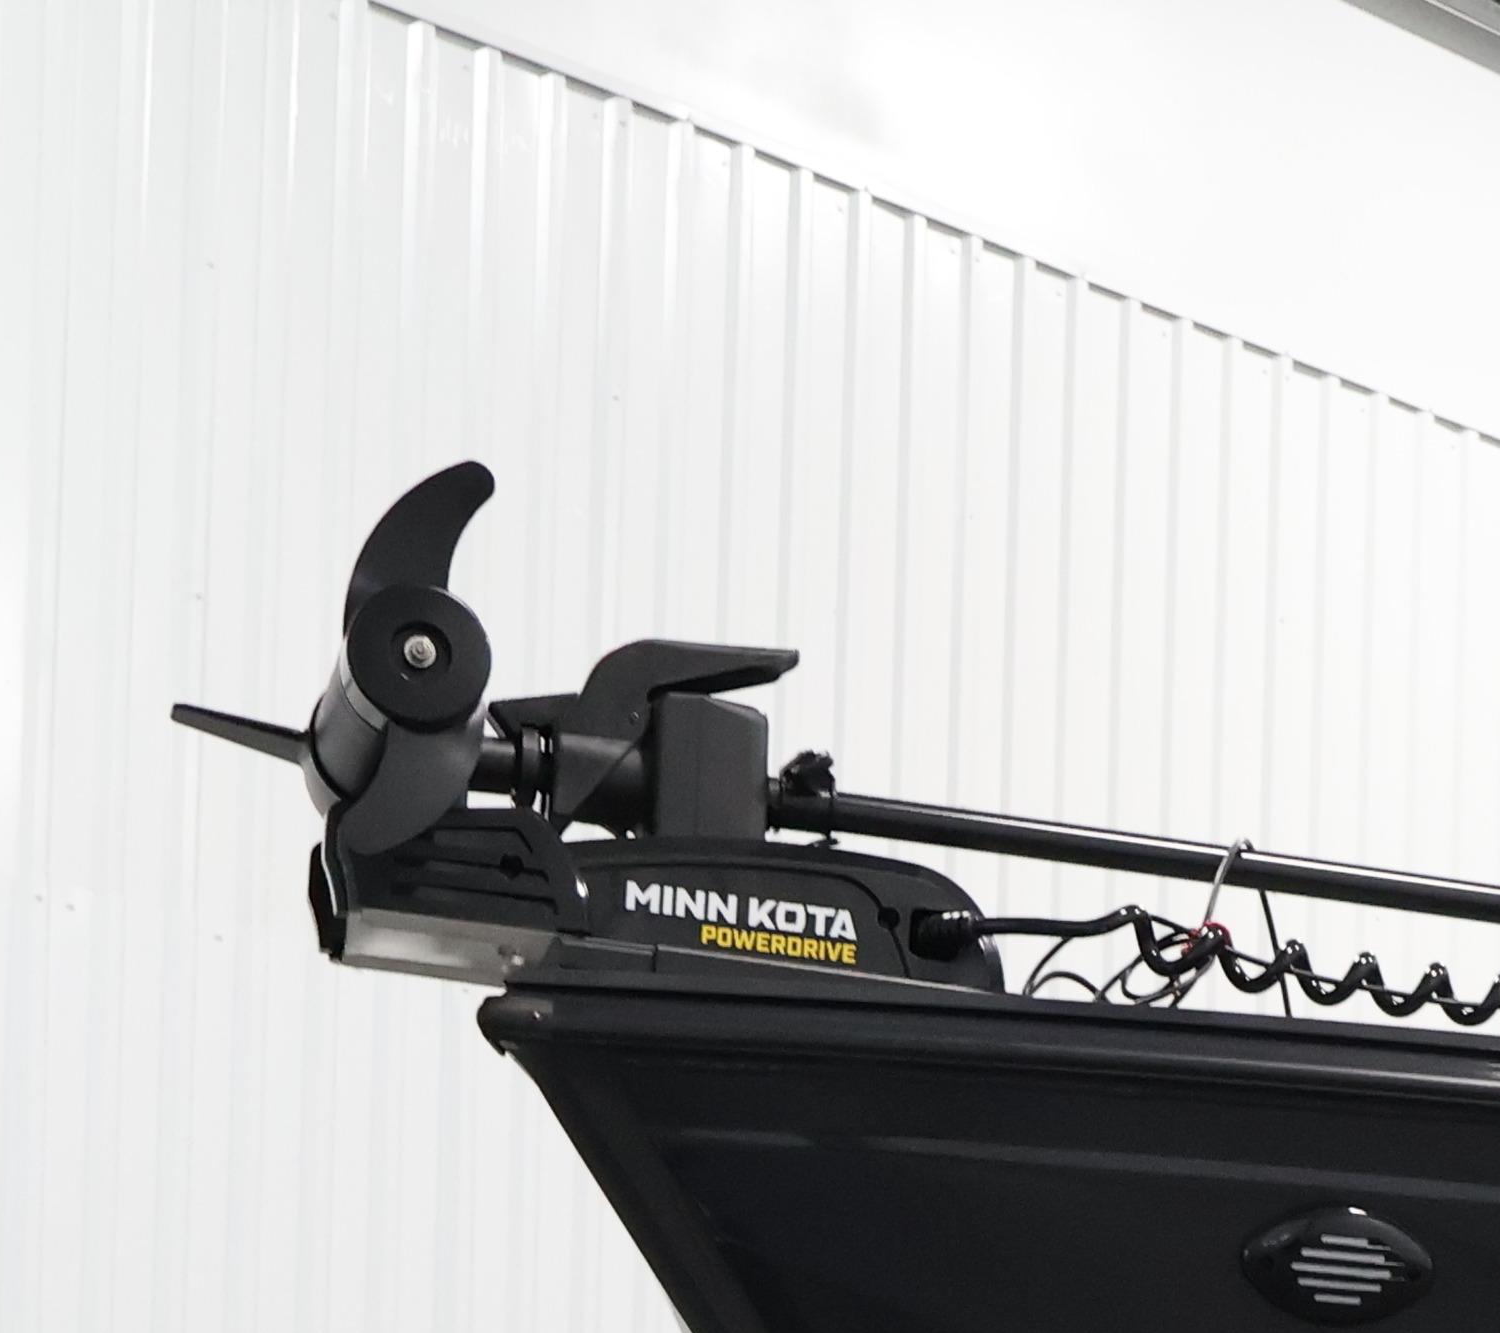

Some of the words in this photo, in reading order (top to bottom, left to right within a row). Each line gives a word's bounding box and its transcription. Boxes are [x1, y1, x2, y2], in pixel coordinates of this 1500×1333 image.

[624, 879, 738, 925] MINN
[747, 896, 857, 941] KOTA
[701, 924, 857, 964] POWERDRIVE
